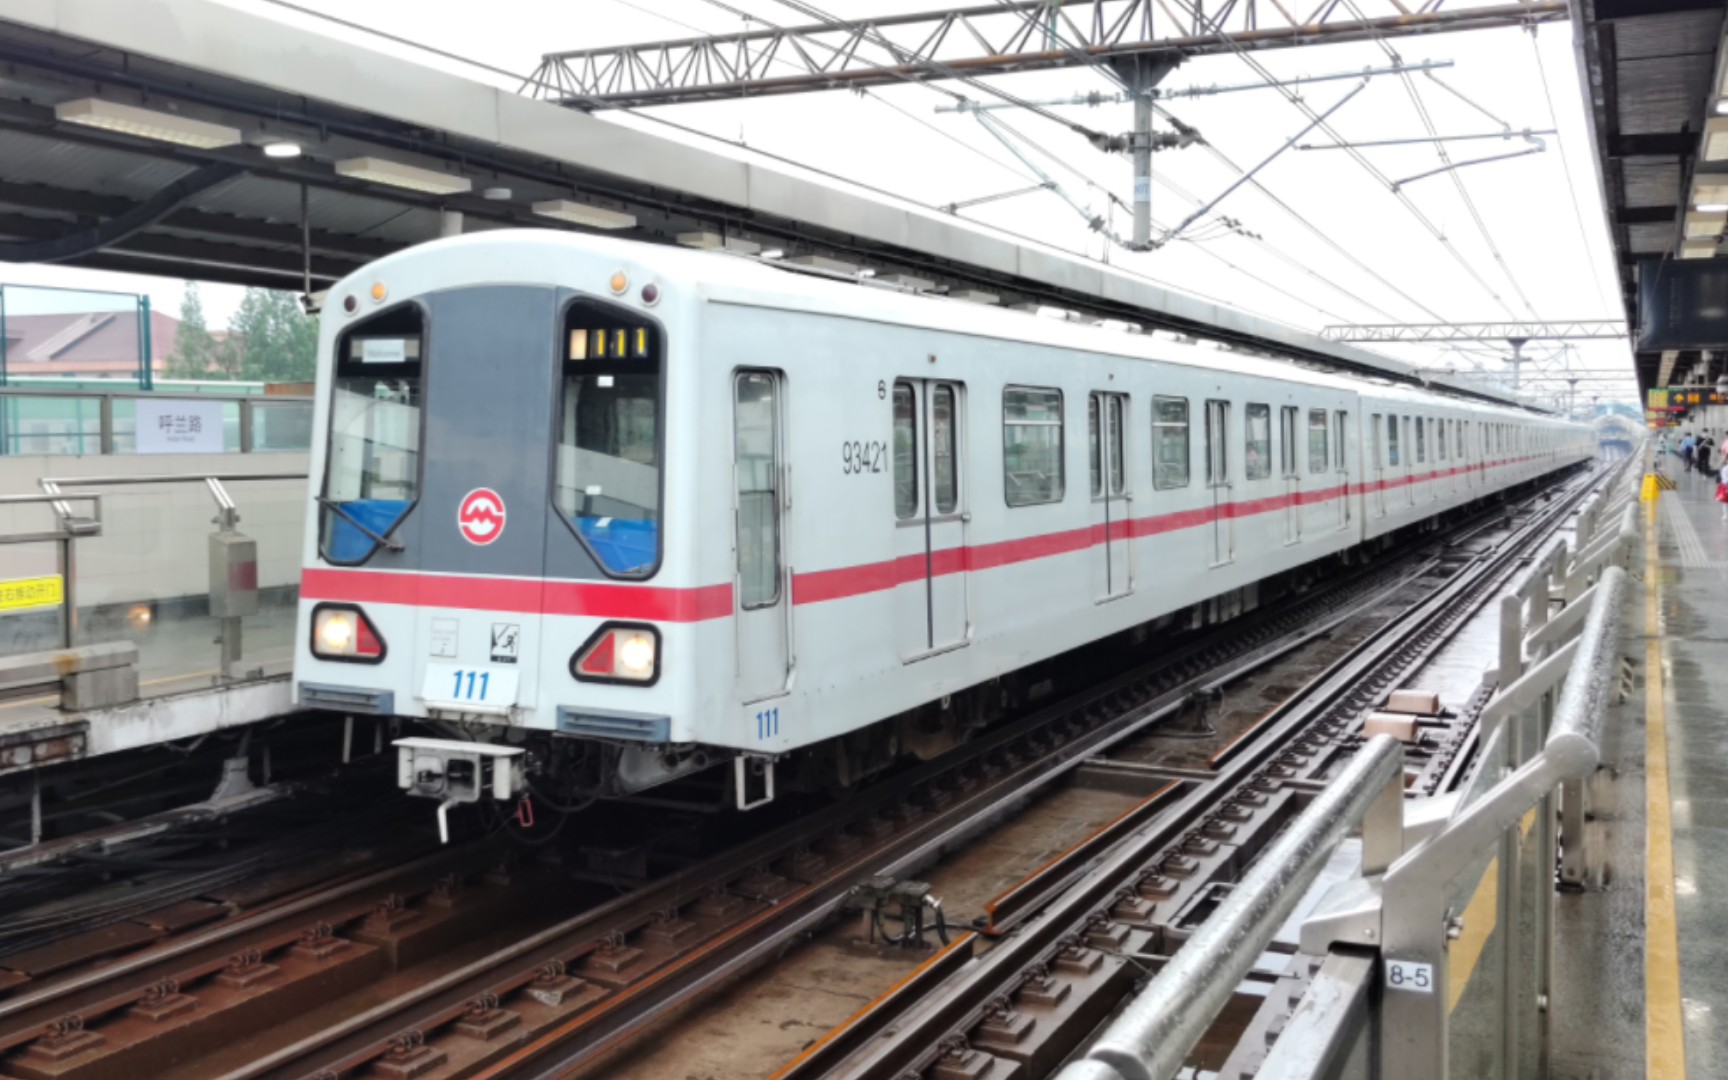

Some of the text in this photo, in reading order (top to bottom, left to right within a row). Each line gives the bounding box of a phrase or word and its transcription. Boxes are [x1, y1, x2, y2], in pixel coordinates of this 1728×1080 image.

[878, 379, 886, 400] 6
[159, 415, 202, 433] 呼兰路
[843, 440, 888, 475] 93421
[453, 670, 489, 700] 111
[756, 707, 778, 740] 111
[1390, 965, 1429, 987] 8-5
